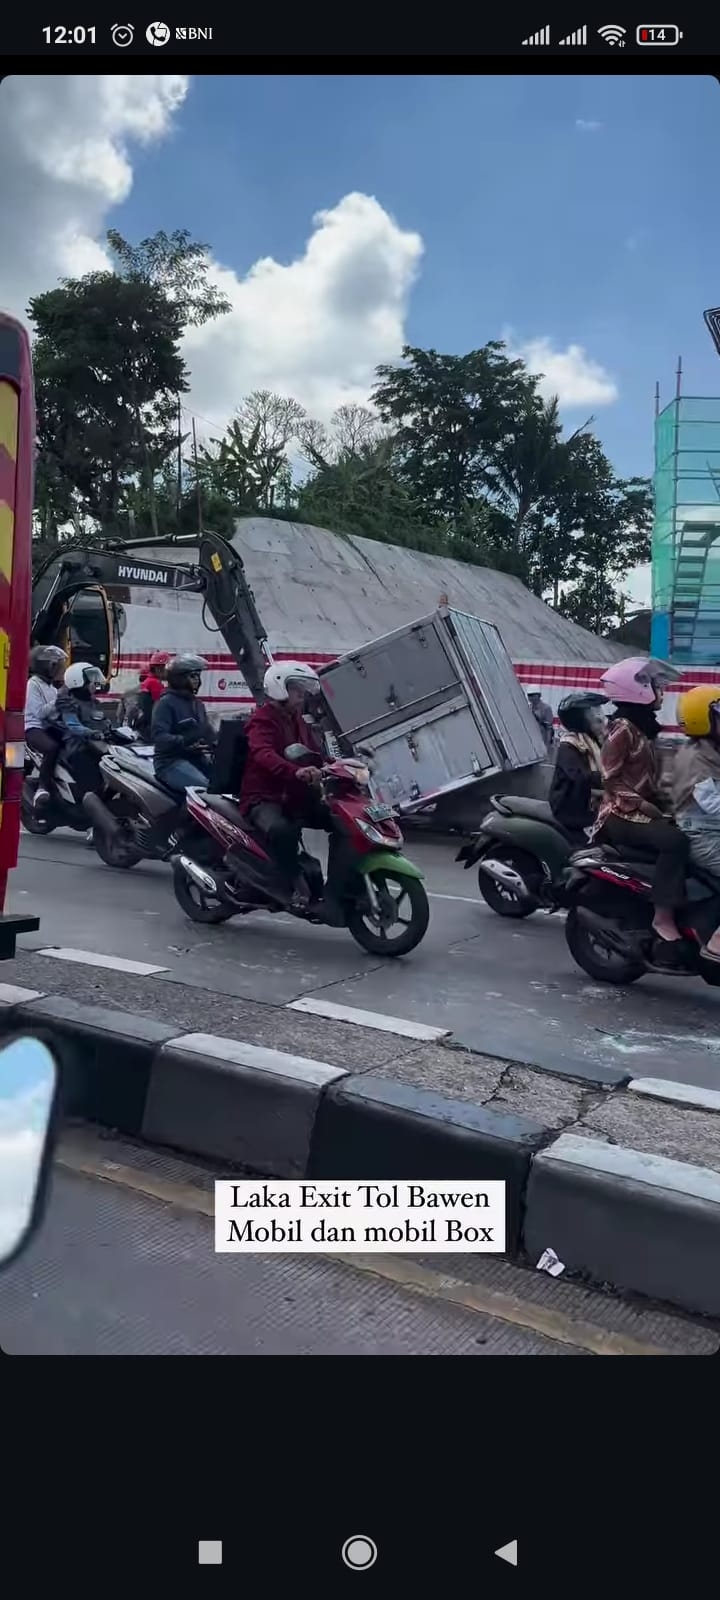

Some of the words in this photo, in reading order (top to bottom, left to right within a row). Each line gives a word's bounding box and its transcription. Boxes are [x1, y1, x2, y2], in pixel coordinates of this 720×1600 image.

[42, 25, 97, 44] 12:01
[188, 27, 213, 40] BNI
[648, 28, 667, 41] 14
[118, 565, 168, 584] HYUNDAI
